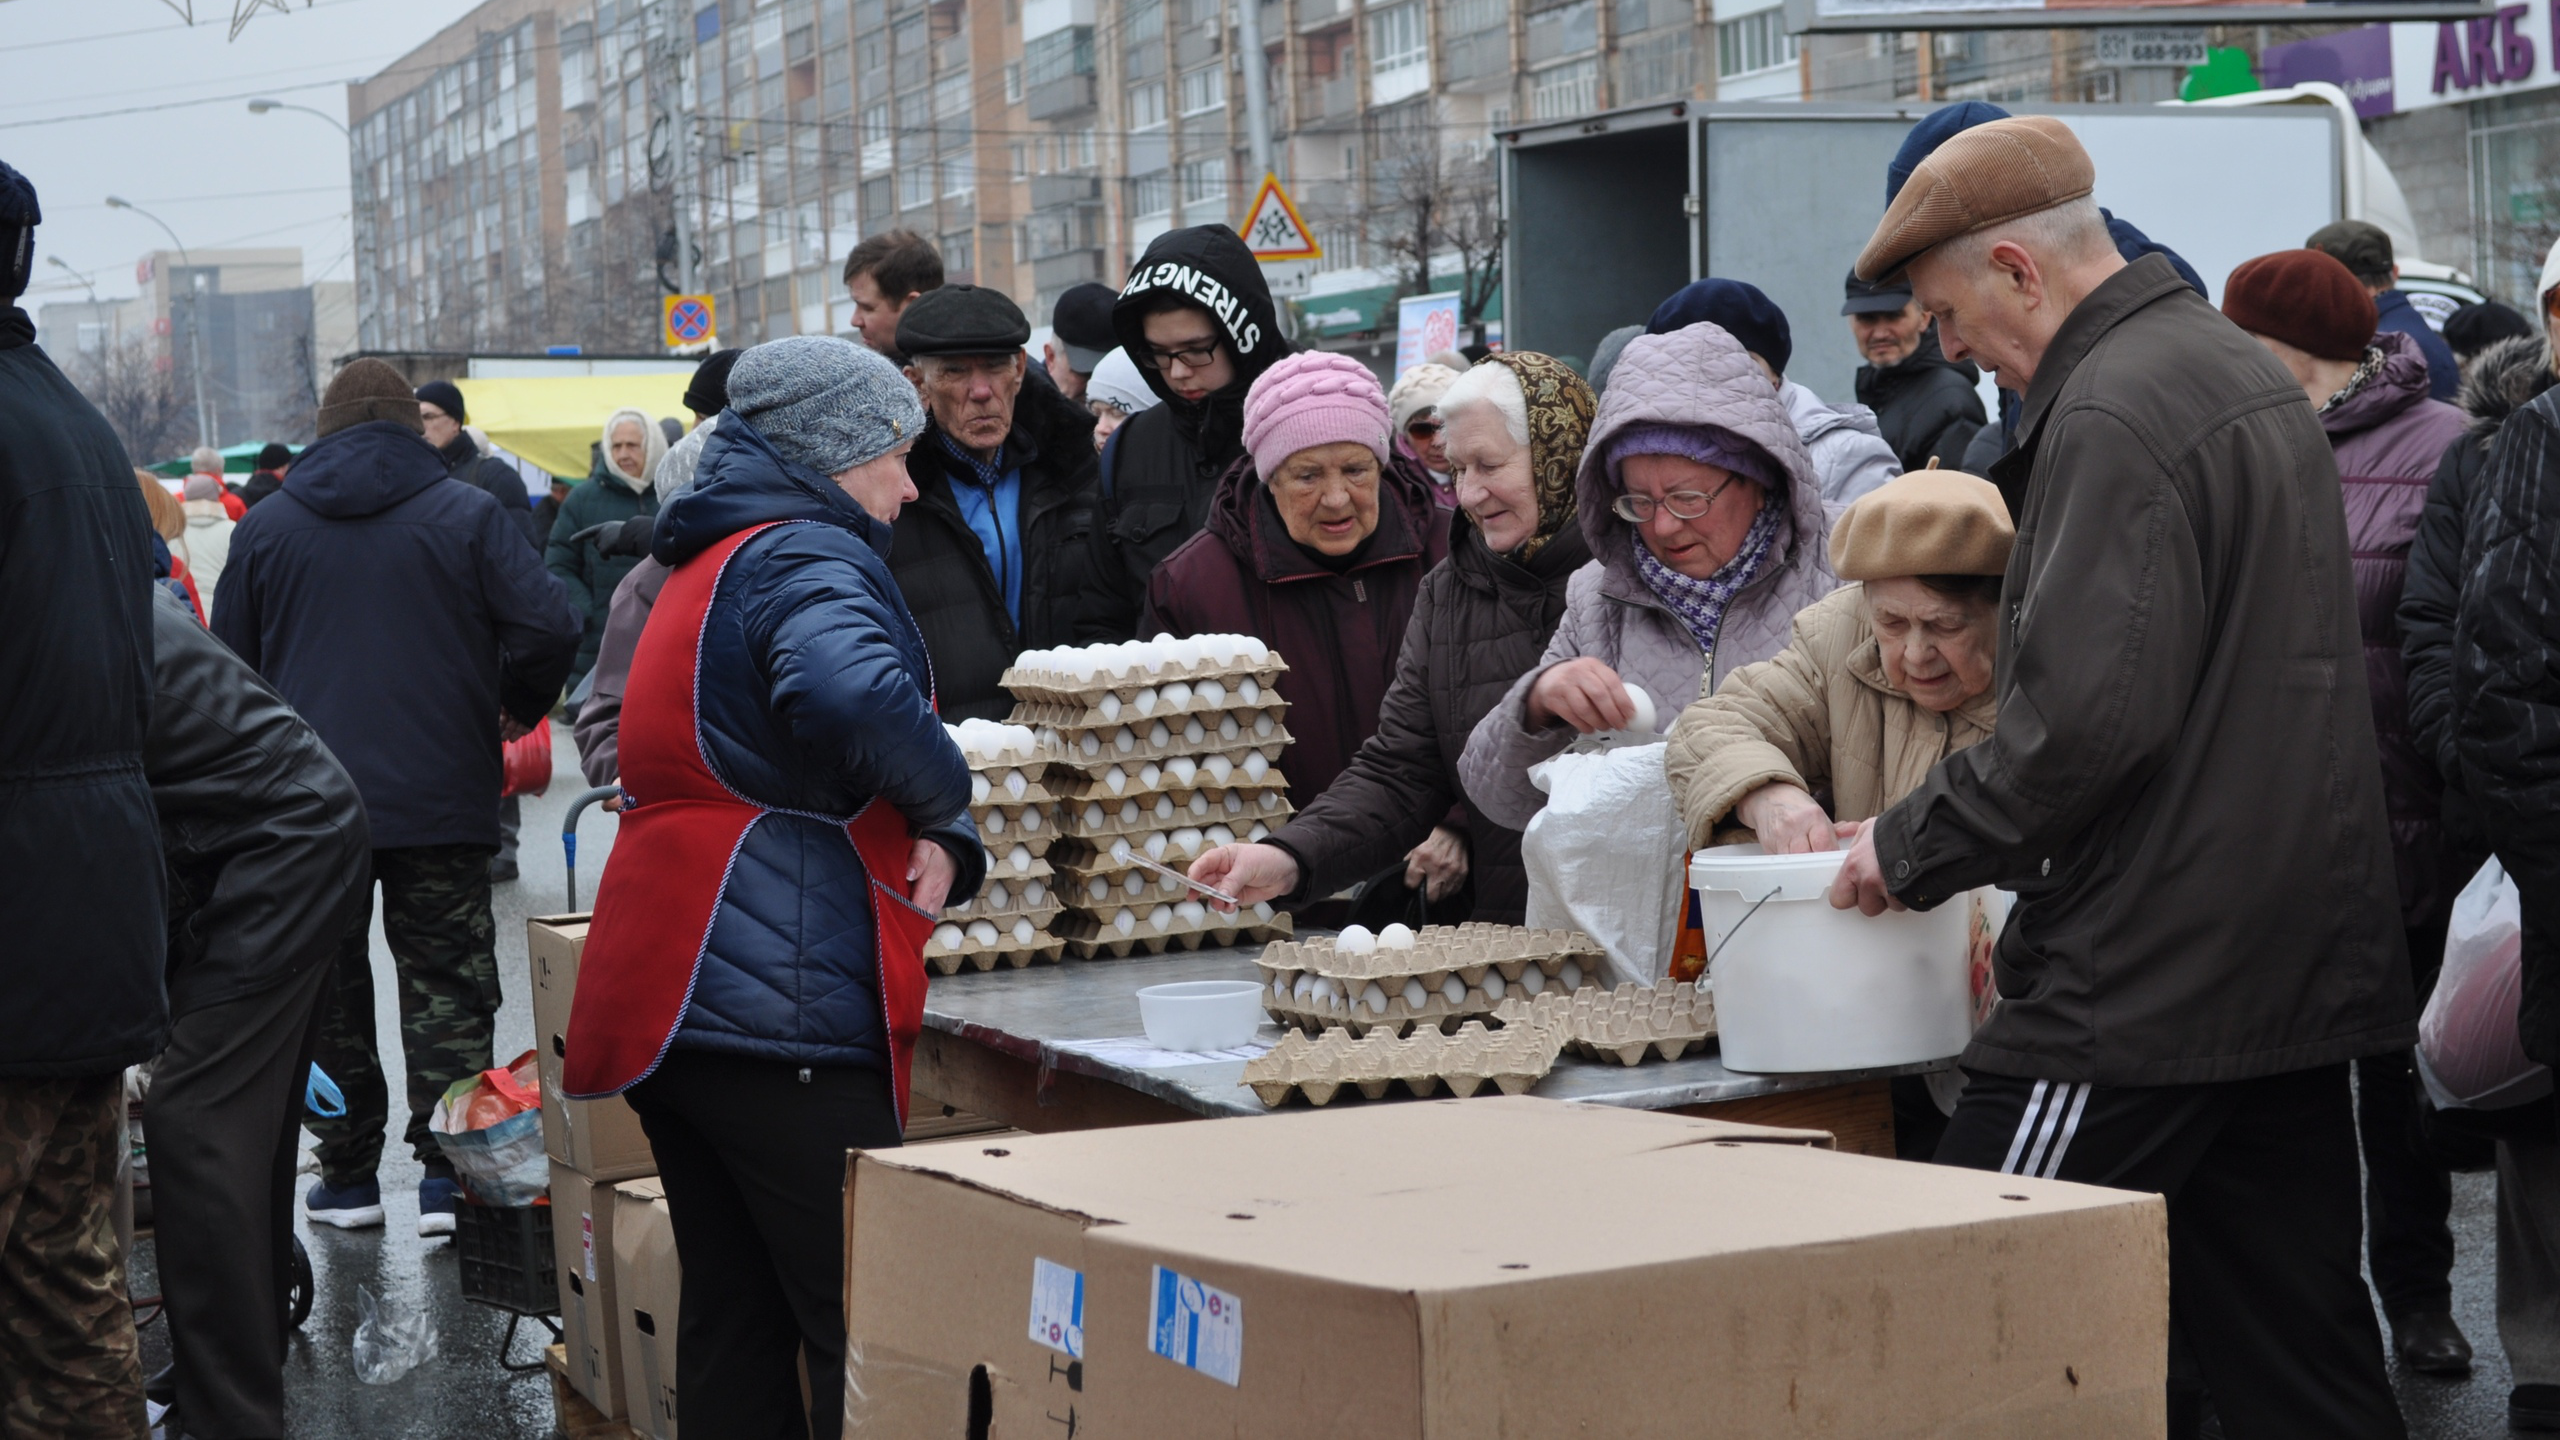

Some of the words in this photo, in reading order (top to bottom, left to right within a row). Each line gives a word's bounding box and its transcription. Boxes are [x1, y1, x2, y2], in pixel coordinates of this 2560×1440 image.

[2131, 44, 2203, 61] 688-993
[2432, 3, 2535, 95] АКБ
[1118, 262, 1261, 354] STRENGTH
